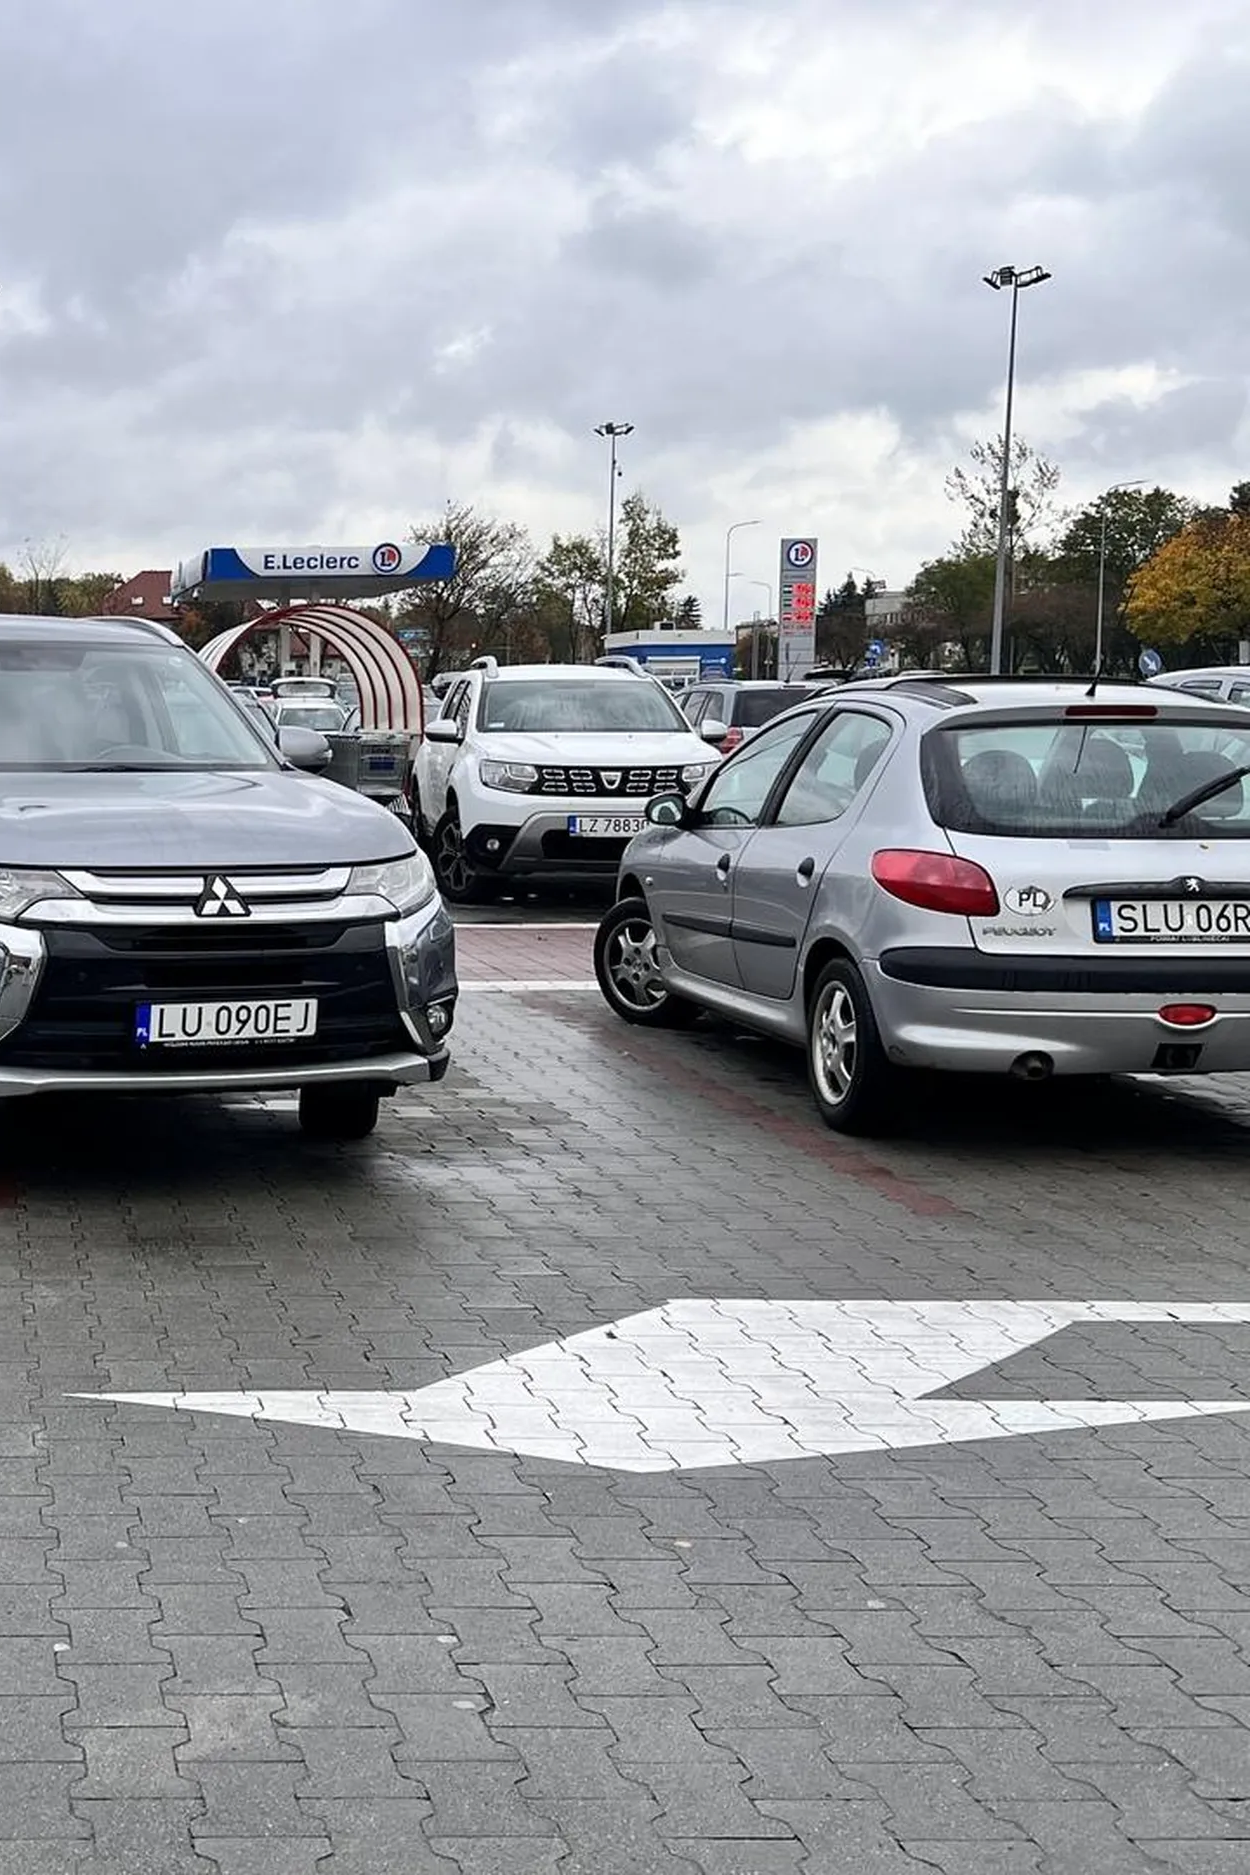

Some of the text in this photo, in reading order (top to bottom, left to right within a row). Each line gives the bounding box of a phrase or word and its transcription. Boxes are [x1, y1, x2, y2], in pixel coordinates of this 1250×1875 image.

[263, 554, 360, 570] E.Leclerc
[579, 819, 598, 832] LZ
[1019, 891, 1043, 907] PL
[1117, 903, 1250, 932] SLU 06R
[158, 1002, 310, 1038] LU 090EJ
